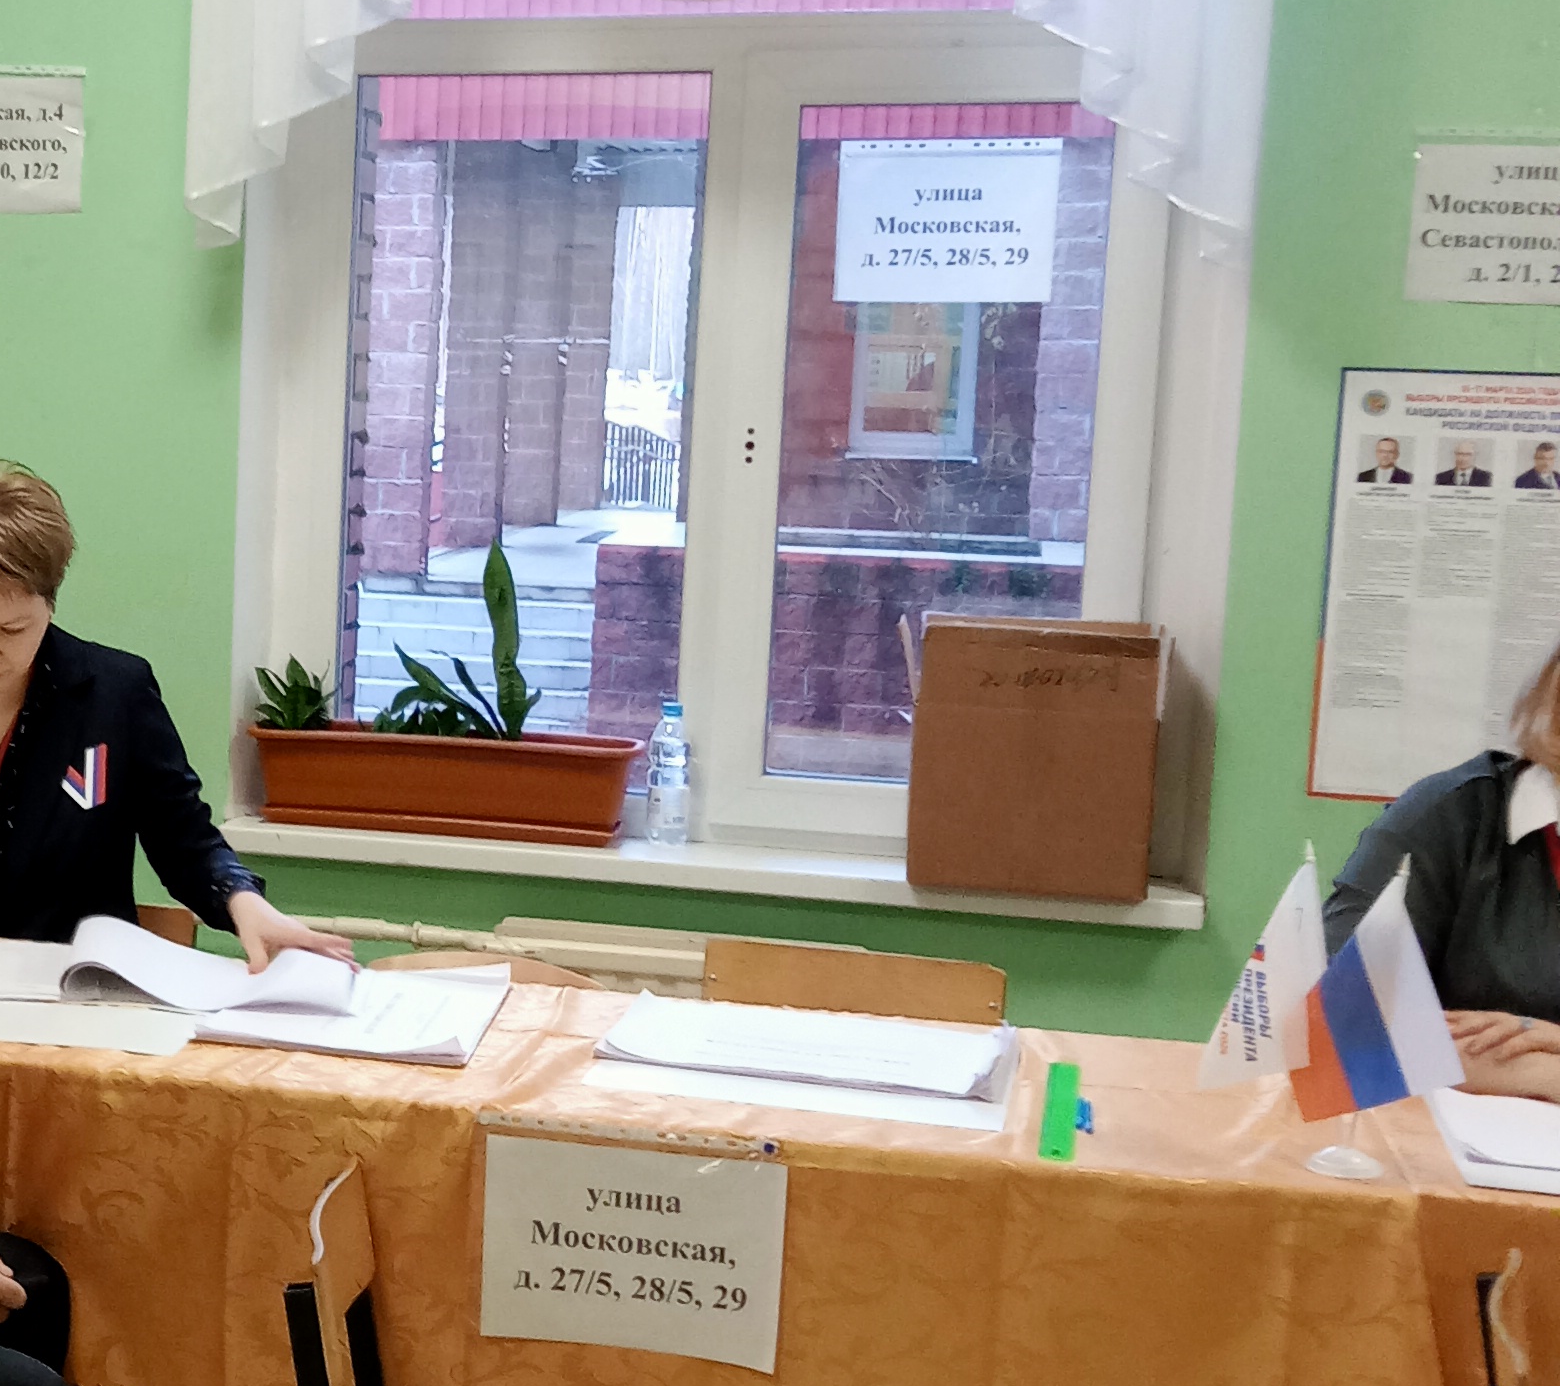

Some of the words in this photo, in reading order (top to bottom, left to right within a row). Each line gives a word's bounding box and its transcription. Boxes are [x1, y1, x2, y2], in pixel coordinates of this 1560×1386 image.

[23, 163, 59, 180] 12/2
[1492, 165, 1559, 185] улиц
[913, 187, 983, 207] улица
[1426, 194, 1560, 216] Московск
[874, 217, 1022, 235] Московская,
[861, 252, 881, 268] д.
[888, 249, 939, 268] 27/5,
[945, 249, 997, 269] 28/5,
[1004, 248, 1030, 266] 29
[1467, 267, 1489, 283] д.
[1496, 264, 1542, 284] 2/1,
[1241, 969, 1258, 1061] ПРЕЗИДЕНТА
[1256, 971, 1272, 1039] ВЫБОРЫ
[585, 1187, 682, 1215] улица
[531, 1219, 737, 1270] Московская,
[513, 1269, 541, 1291] д.
[550, 1267, 622, 1301] 27/5,
[631, 1275, 703, 1311] 28/5,
[711, 1285, 748, 1312] 29
